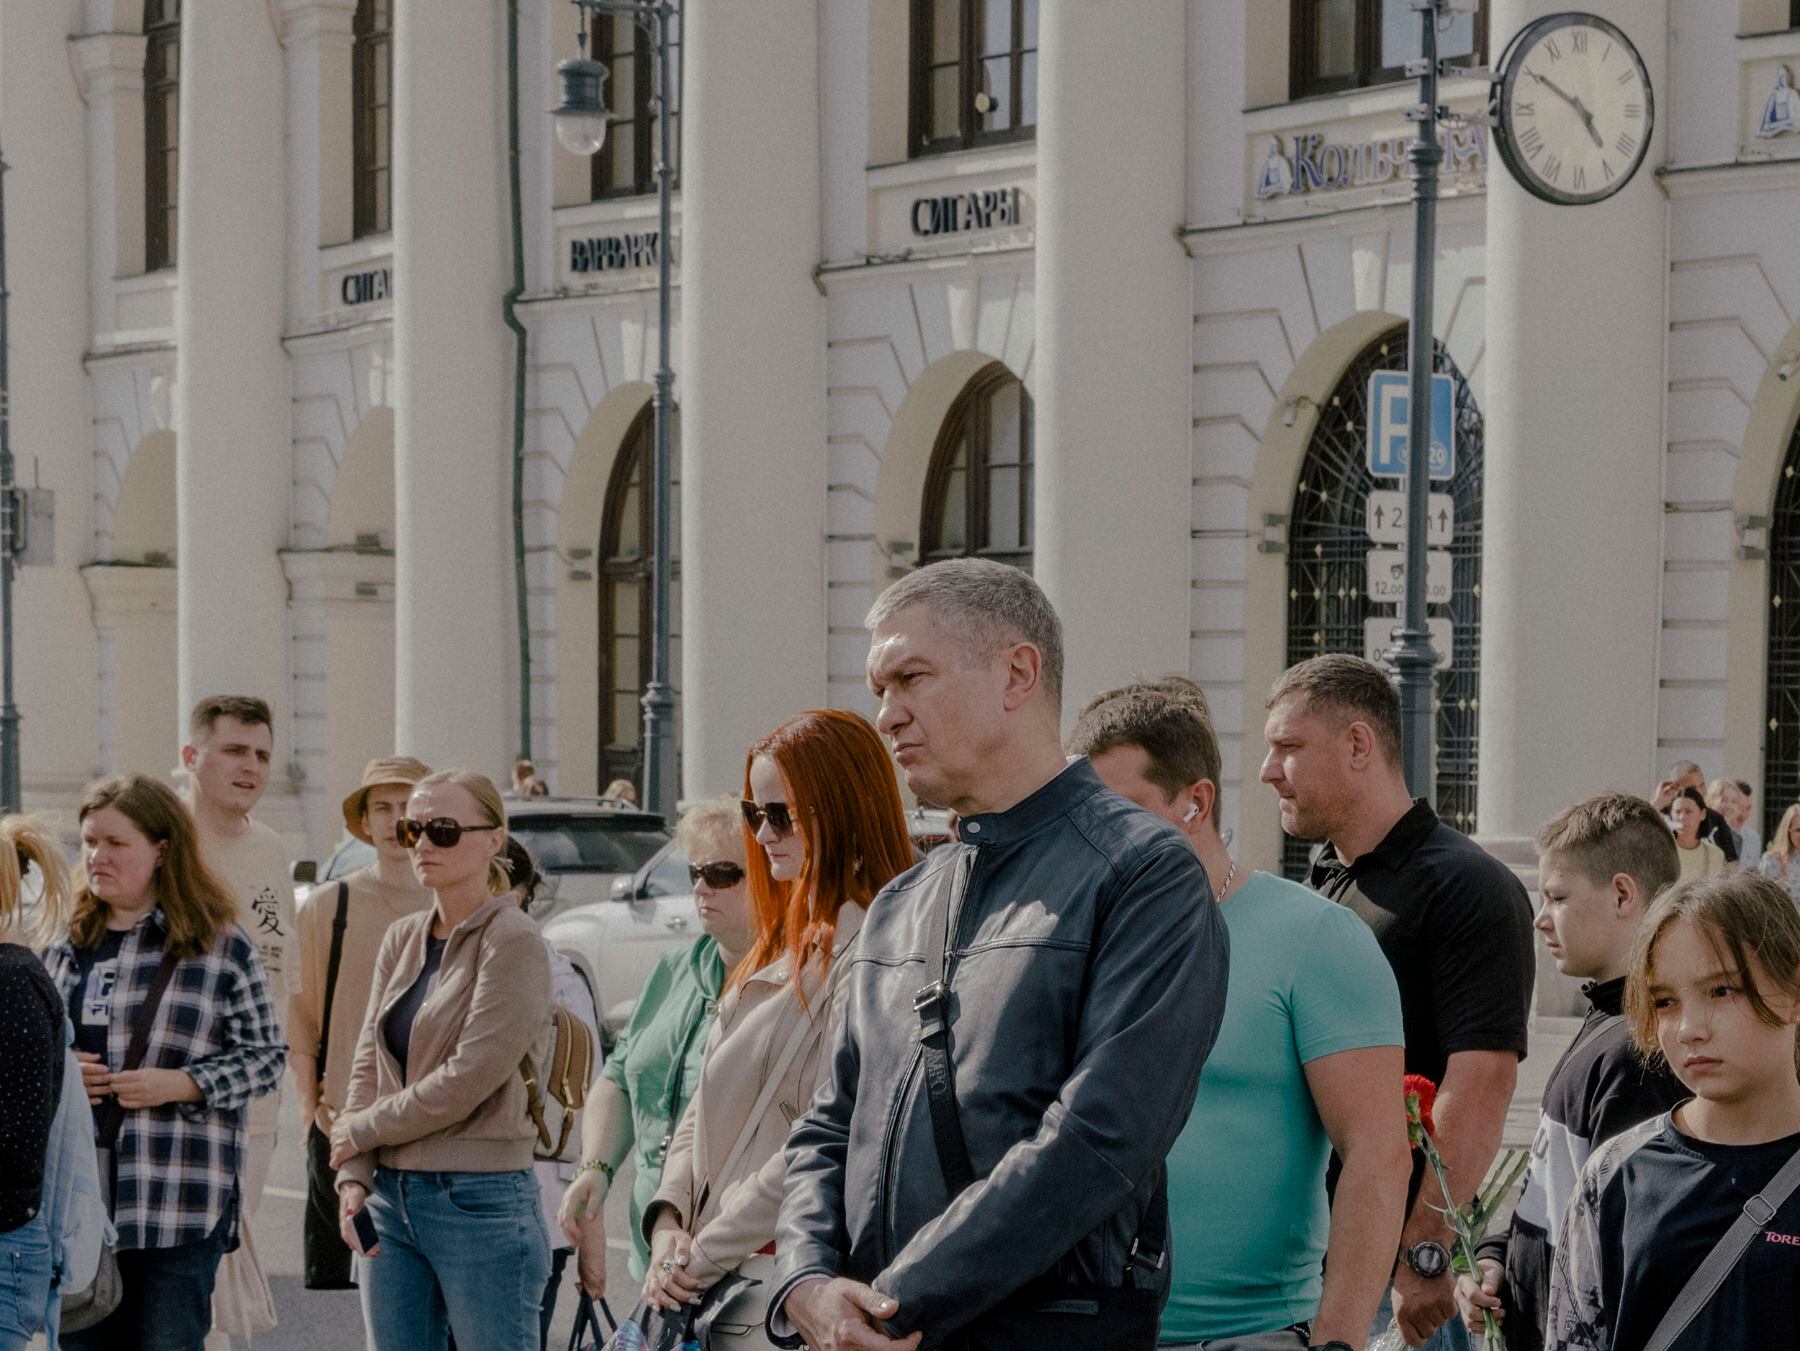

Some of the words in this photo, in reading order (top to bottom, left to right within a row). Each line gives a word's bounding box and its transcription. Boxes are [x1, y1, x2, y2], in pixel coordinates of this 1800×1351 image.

[1293, 126, 1487, 191] КОЛЬЧГА
[911, 187, 1020, 236] СИГАРЫ
[571, 232, 674, 272] ВАРВАРК
[1375, 582, 1404, 596] 12.00
[251, 886, 284, 936] 愛
